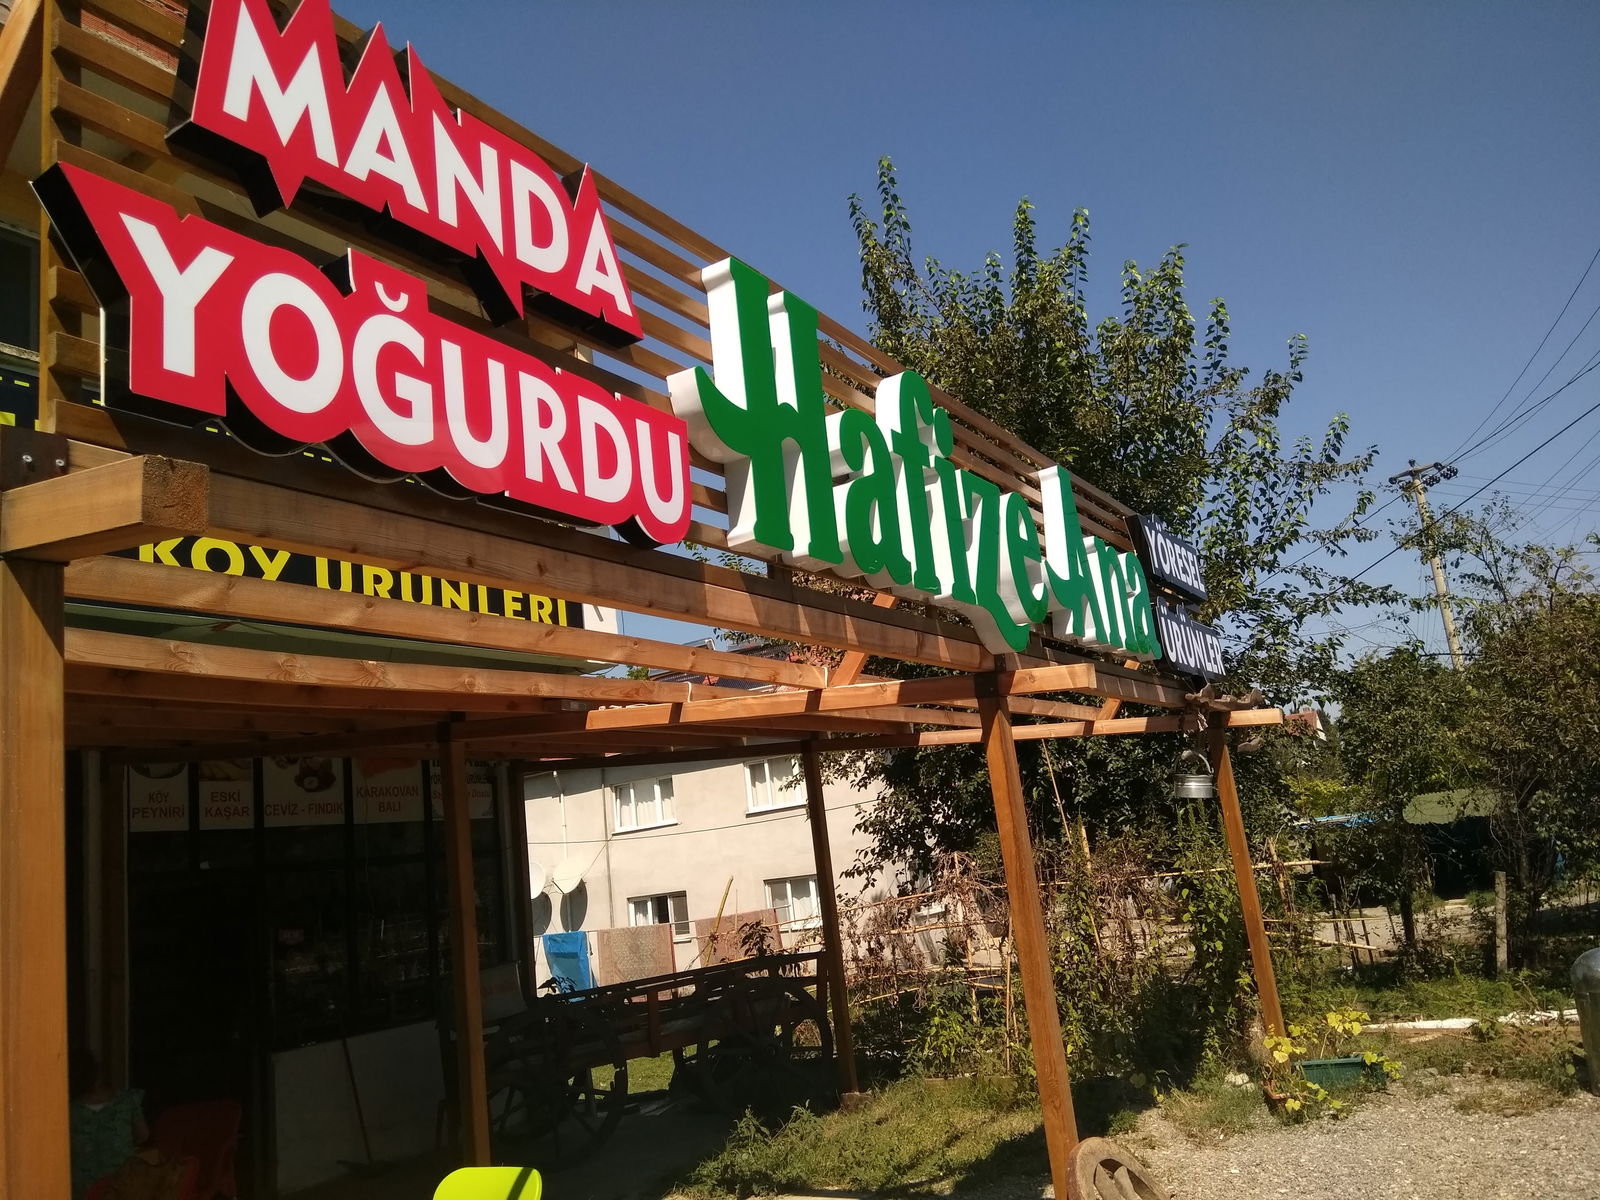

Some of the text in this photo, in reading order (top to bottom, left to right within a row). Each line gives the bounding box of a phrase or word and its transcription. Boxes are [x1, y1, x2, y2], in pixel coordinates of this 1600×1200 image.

[222, 0, 633, 318] MANDA
[119, 212, 681, 525] YOĞURDU
[694, 256, 1162, 661] Hafize Ana
[1144, 522, 1206, 593] YÖRESEL
[1161, 604, 1227, 676] ÜRÜNLER
[131, 804, 185, 819] PEYNİRİ
[204, 806, 251, 820] KAŞAR
[210, 789, 241, 802] ESKİ
[355, 785, 419, 798] KARAKOVAN
